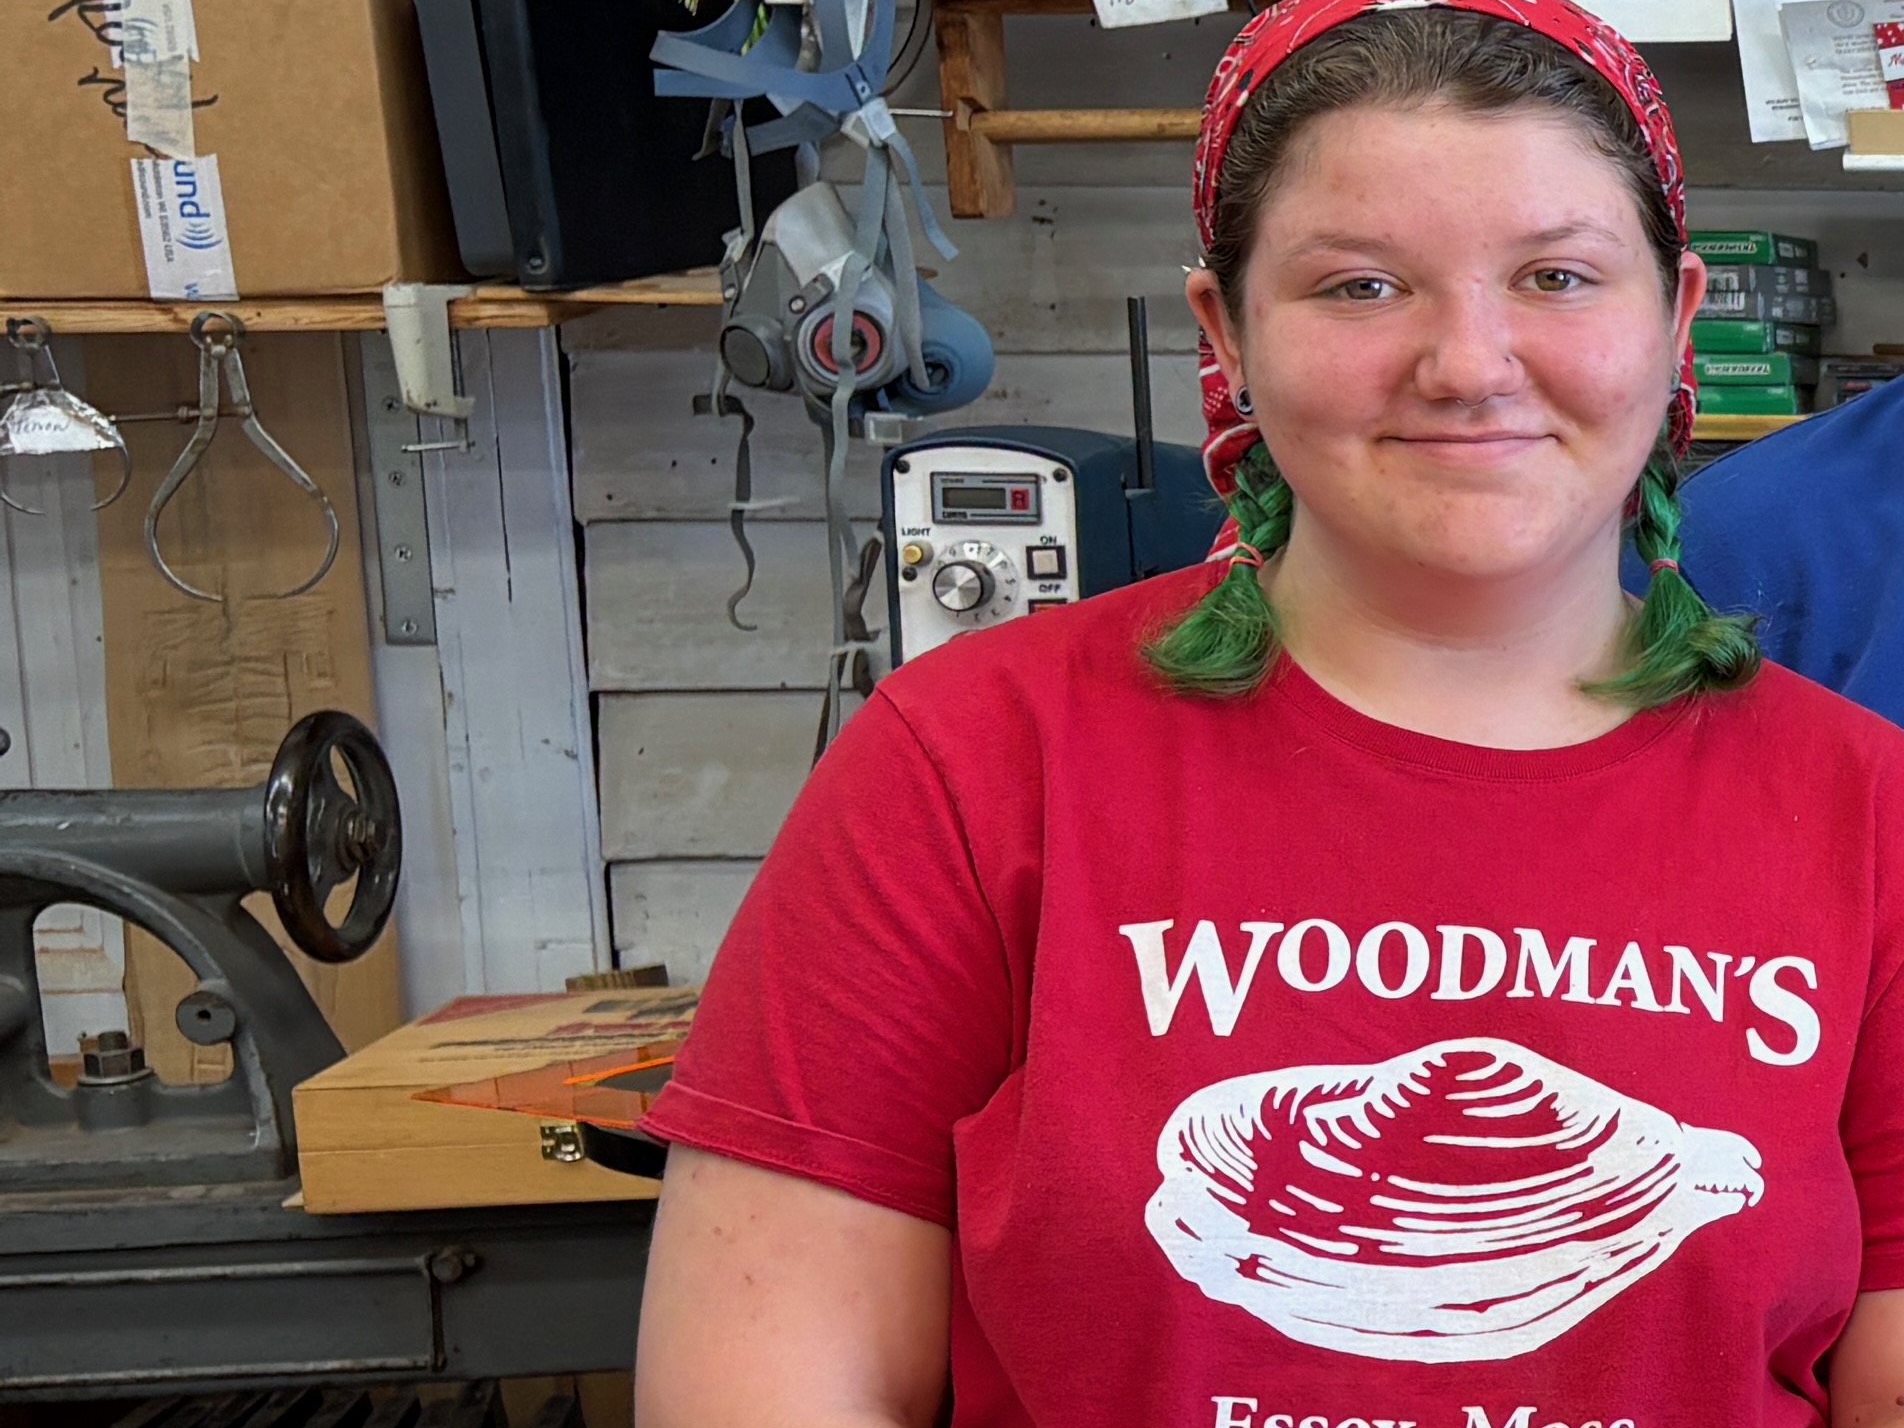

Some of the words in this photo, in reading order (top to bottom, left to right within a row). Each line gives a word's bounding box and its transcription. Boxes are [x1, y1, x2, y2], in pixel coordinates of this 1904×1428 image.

[901, 527, 931, 537] LIGHT
[1040, 536, 1057, 546] ON
[1039, 584, 1061, 593] OFF
[1119, 919, 1821, 1066] WOODMAN'S
